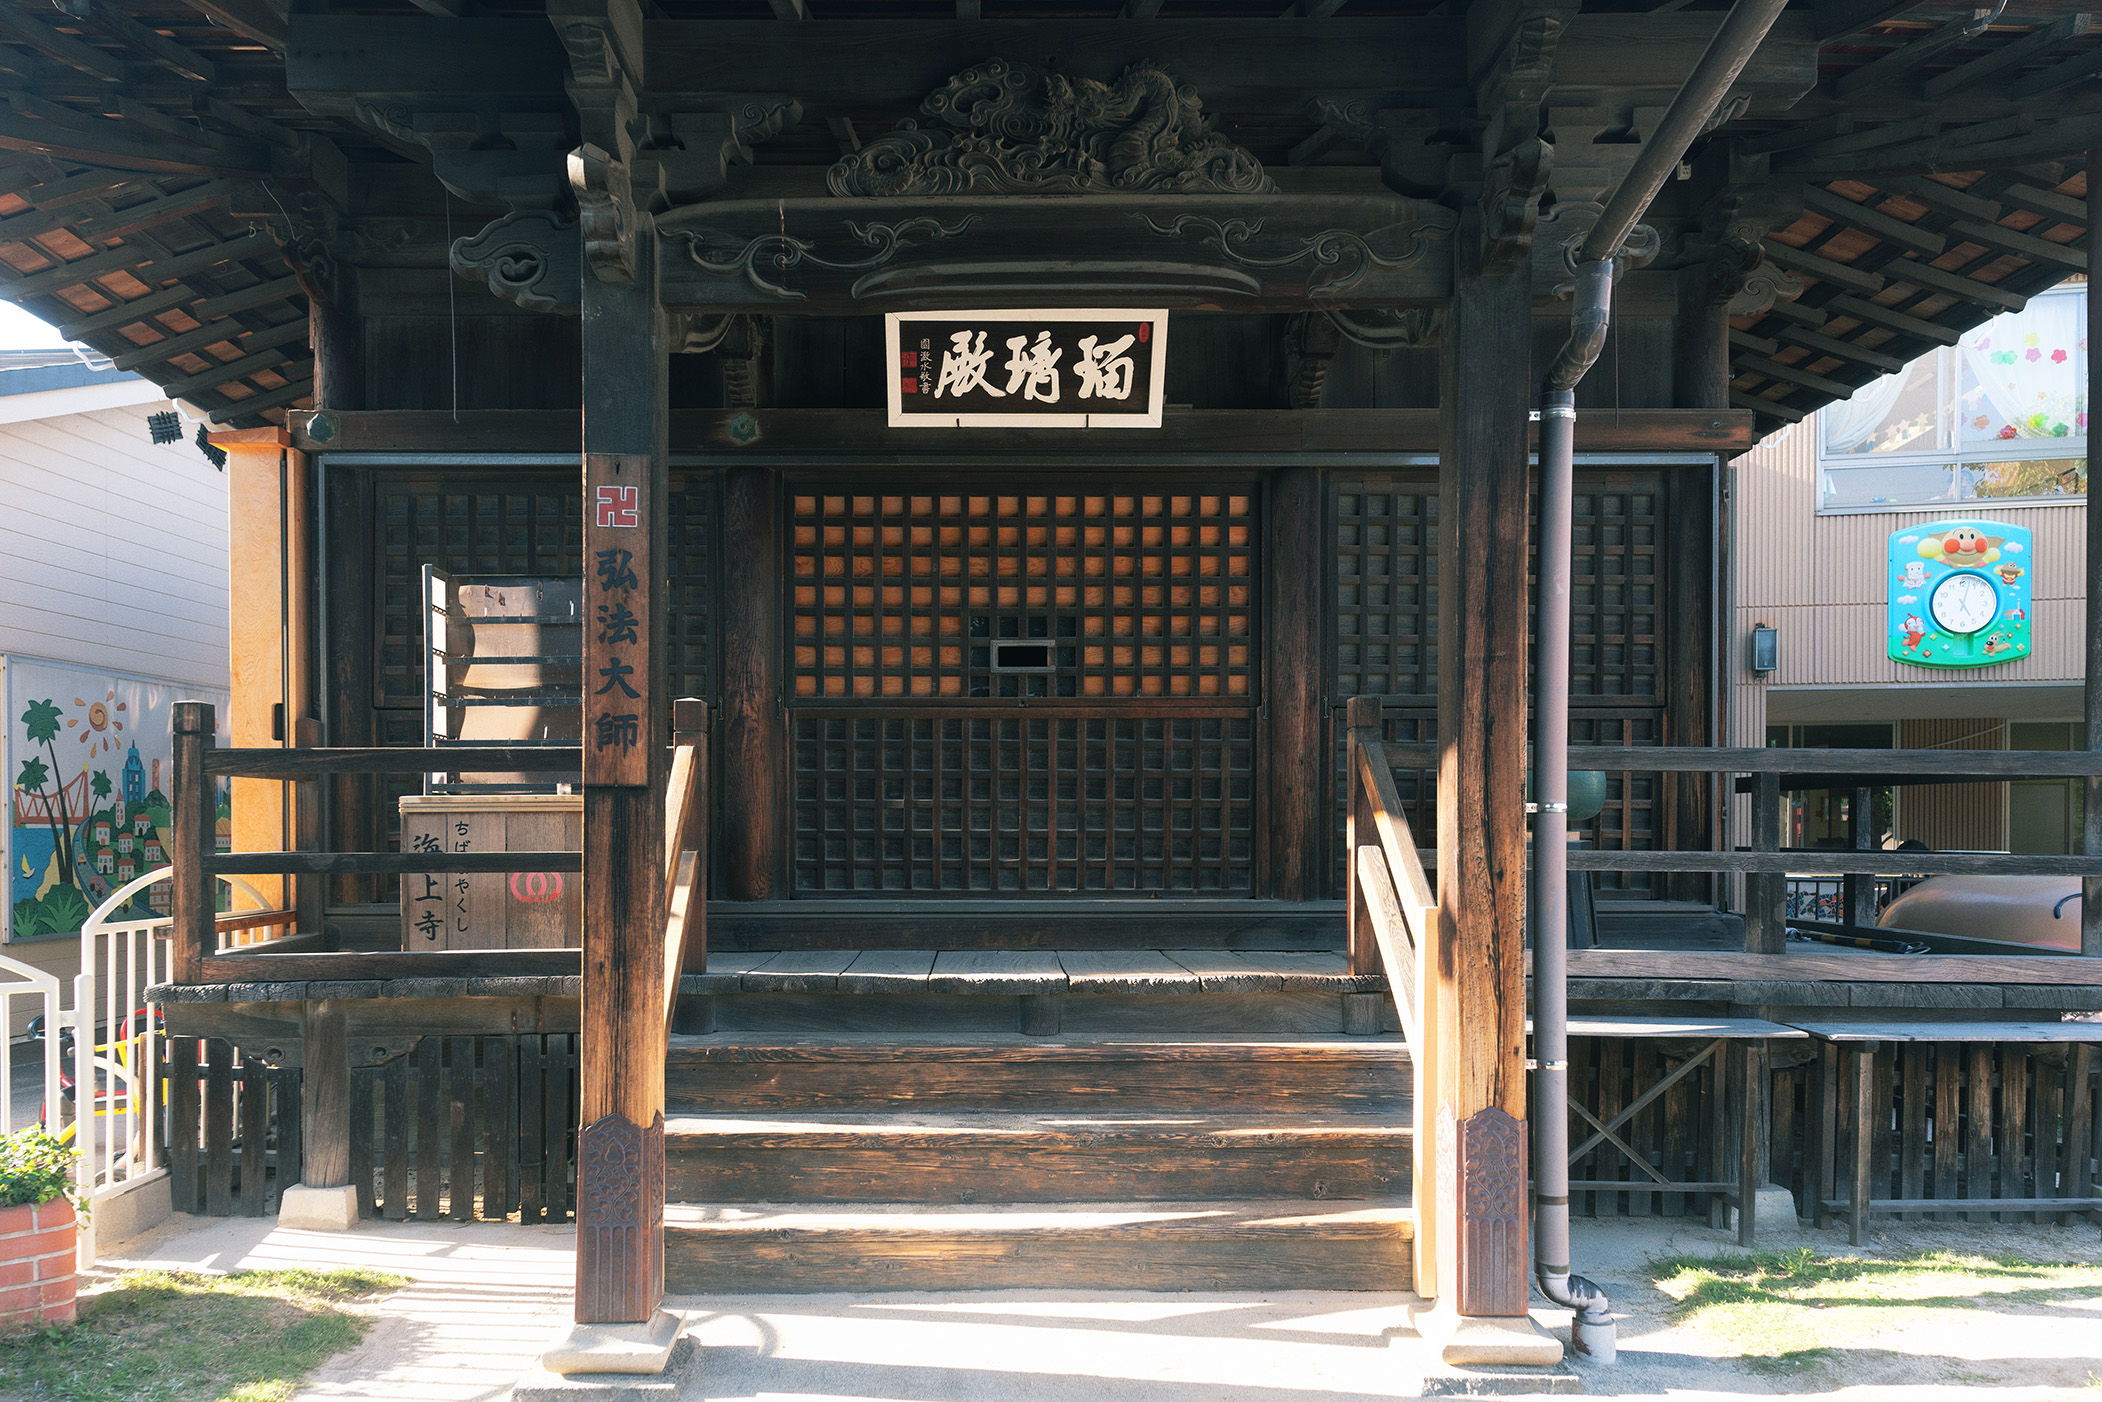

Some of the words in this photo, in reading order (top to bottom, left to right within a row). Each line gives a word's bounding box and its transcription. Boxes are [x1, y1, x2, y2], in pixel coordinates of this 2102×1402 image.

[594, 547, 642, 758] 弘法大師
[412, 833, 444, 941] 海上寺
[455, 820, 471, 933] ちばやくし
